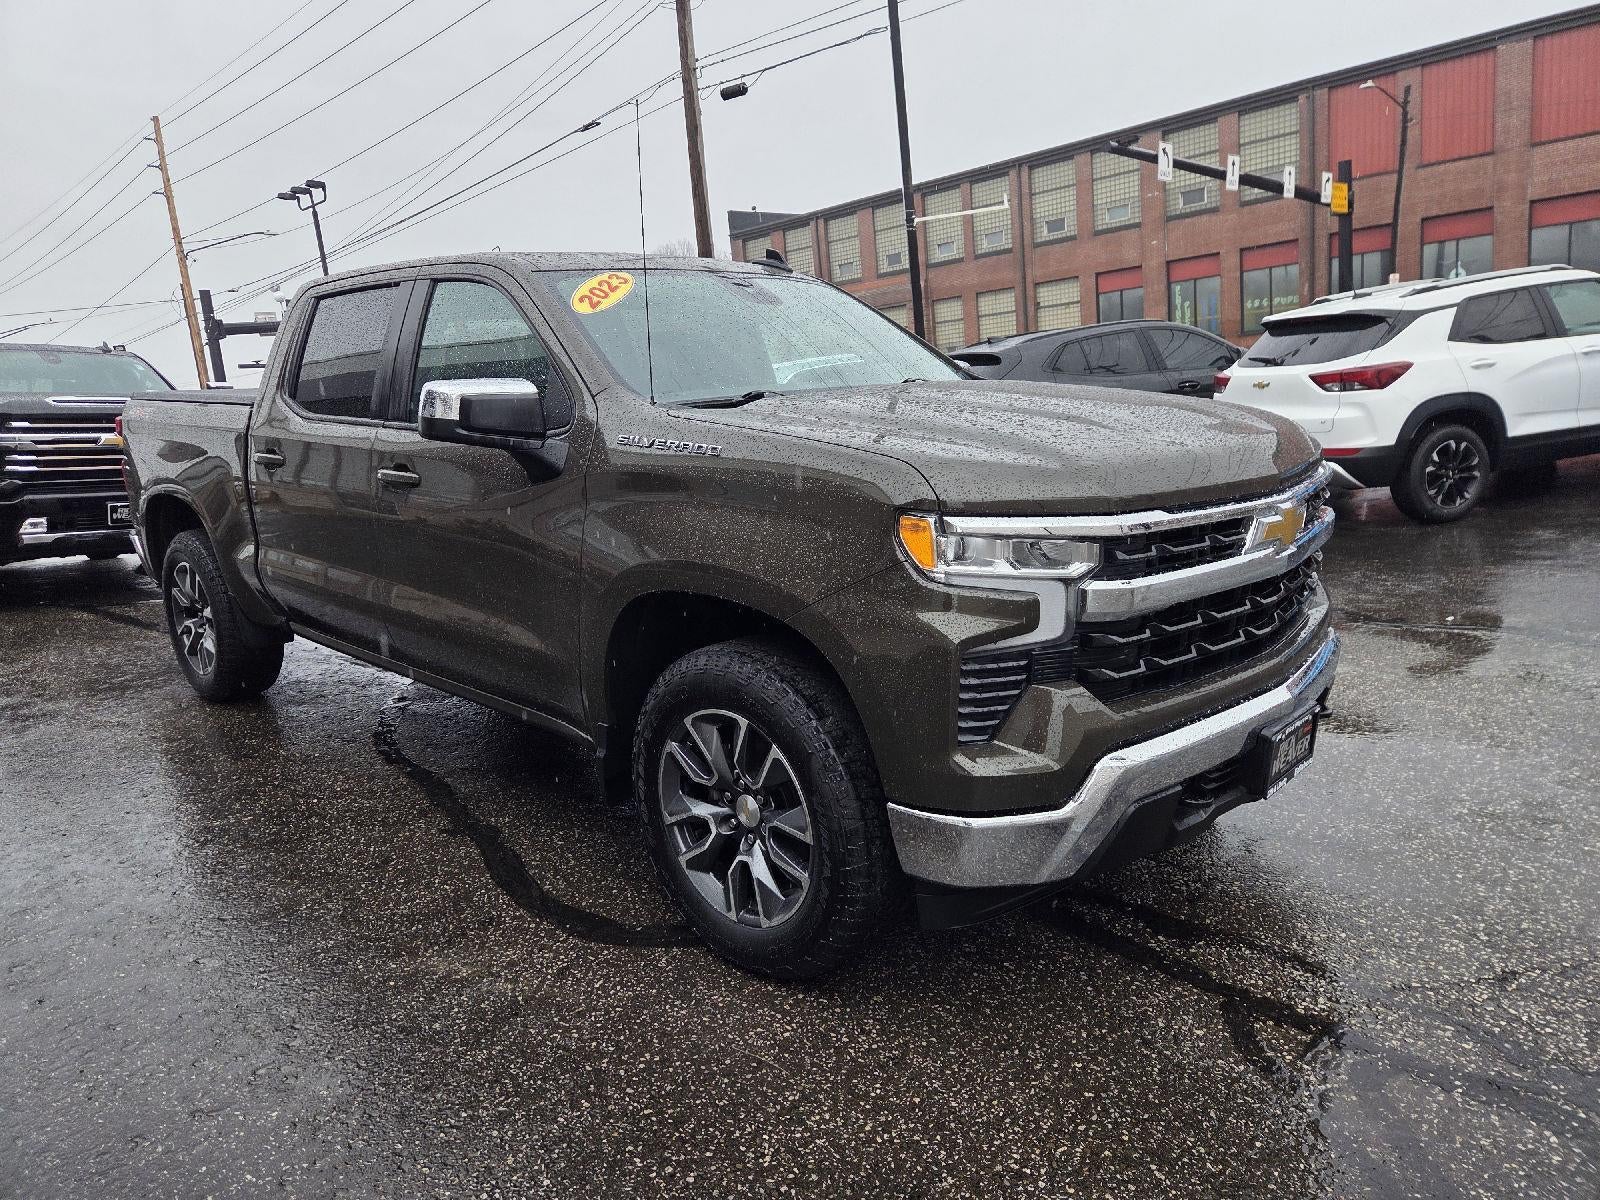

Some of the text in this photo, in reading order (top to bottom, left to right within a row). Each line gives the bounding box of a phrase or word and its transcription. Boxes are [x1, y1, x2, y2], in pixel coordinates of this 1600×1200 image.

[578, 273, 630, 311] 2023
[616, 434, 722, 458] SILVERADO
[1271, 734, 1311, 776] WEAVER
